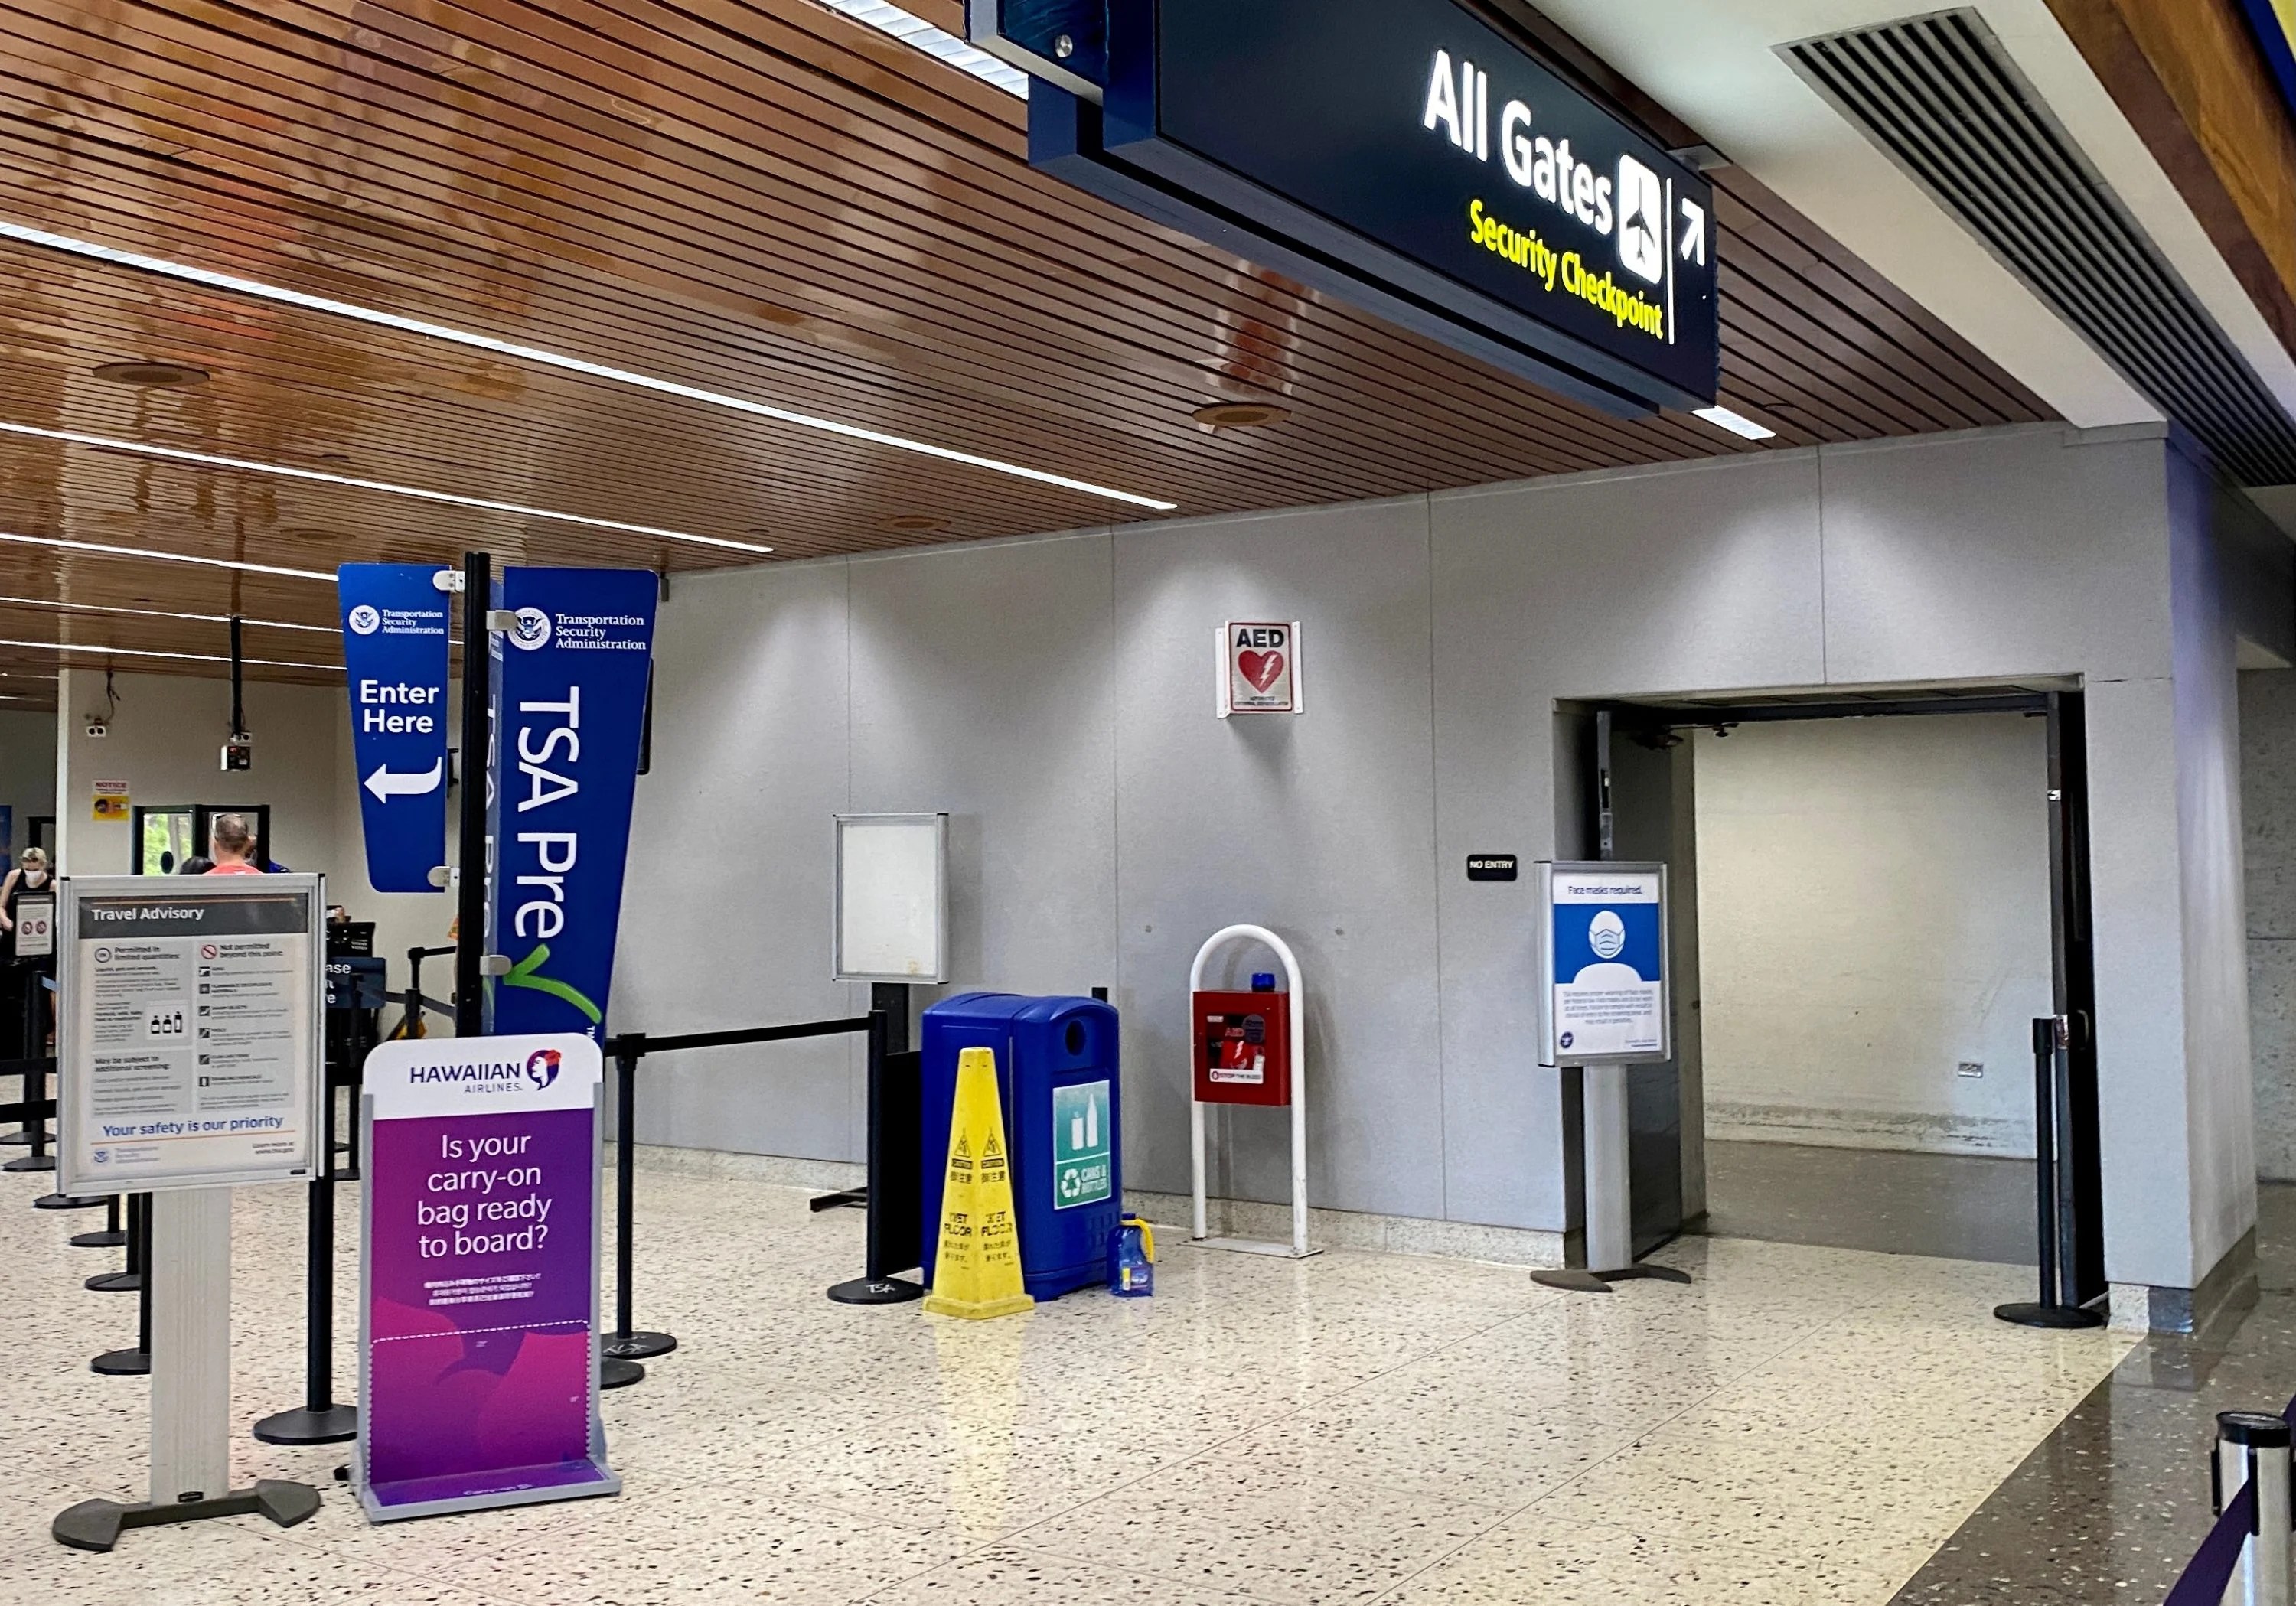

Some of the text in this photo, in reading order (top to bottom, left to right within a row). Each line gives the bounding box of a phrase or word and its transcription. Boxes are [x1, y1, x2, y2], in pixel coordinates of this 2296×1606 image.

[1424, 49, 1613, 236] All Gates
[1469, 199, 1664, 340] Security Checkpoint
[382, 609, 443, 619] Transportation
[382, 618, 417, 627] Security
[555, 614, 644, 627] Transportation
[382, 626, 445, 634] Administration
[555, 626, 606, 640] Security
[1236, 628, 1285, 648] AED
[555, 638, 646, 650] Administration
[360, 679, 440, 704] Enter
[364, 709, 434, 733] Here
[514, 686, 579, 938] TSA Pre
[1469, 860, 1514, 868] NO ENTRY
[1567, 885, 1585, 894] Face
[1586, 886, 1608, 894] masks
[91, 906, 204, 921] Travel Advisory
[325, 963, 351, 974] ase
[410, 1062, 521, 1084] HAWAIIAN
[103, 1116, 285, 1136] Your safety is our priority
[442, 1135, 532, 1163] Is your
[427, 1167, 542, 1194] carry-on
[417, 1193, 553, 1229] bag ready
[419, 1223, 549, 1258] to board?
